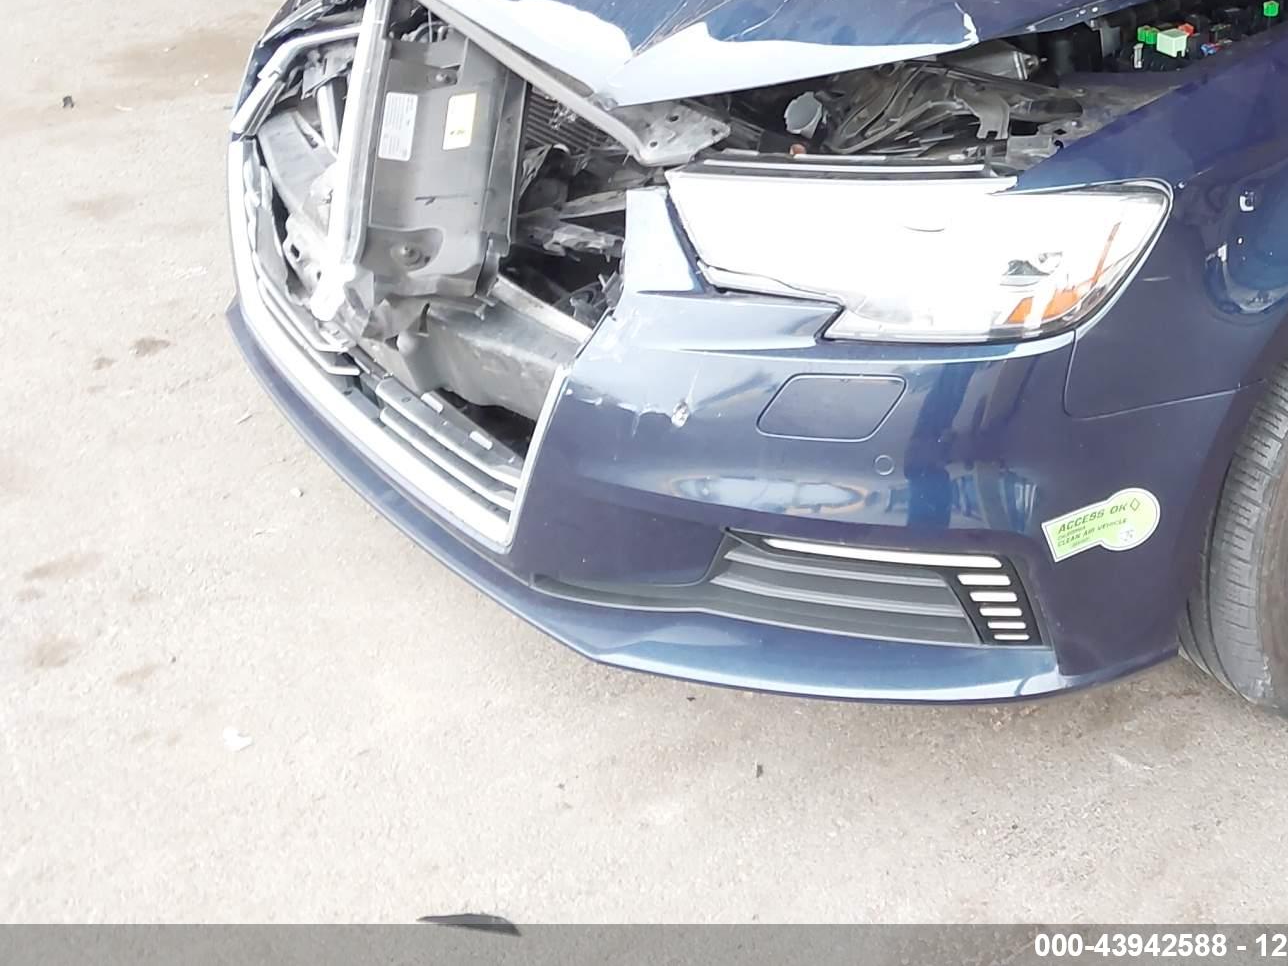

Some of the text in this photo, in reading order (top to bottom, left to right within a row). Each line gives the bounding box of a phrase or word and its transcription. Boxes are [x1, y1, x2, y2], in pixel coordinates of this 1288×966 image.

[1057, 534, 1081, 547] CLEAN
[1097, 518, 1128, 531] VEHICLE
[1058, 502, 1128, 534] ACCESS OK
